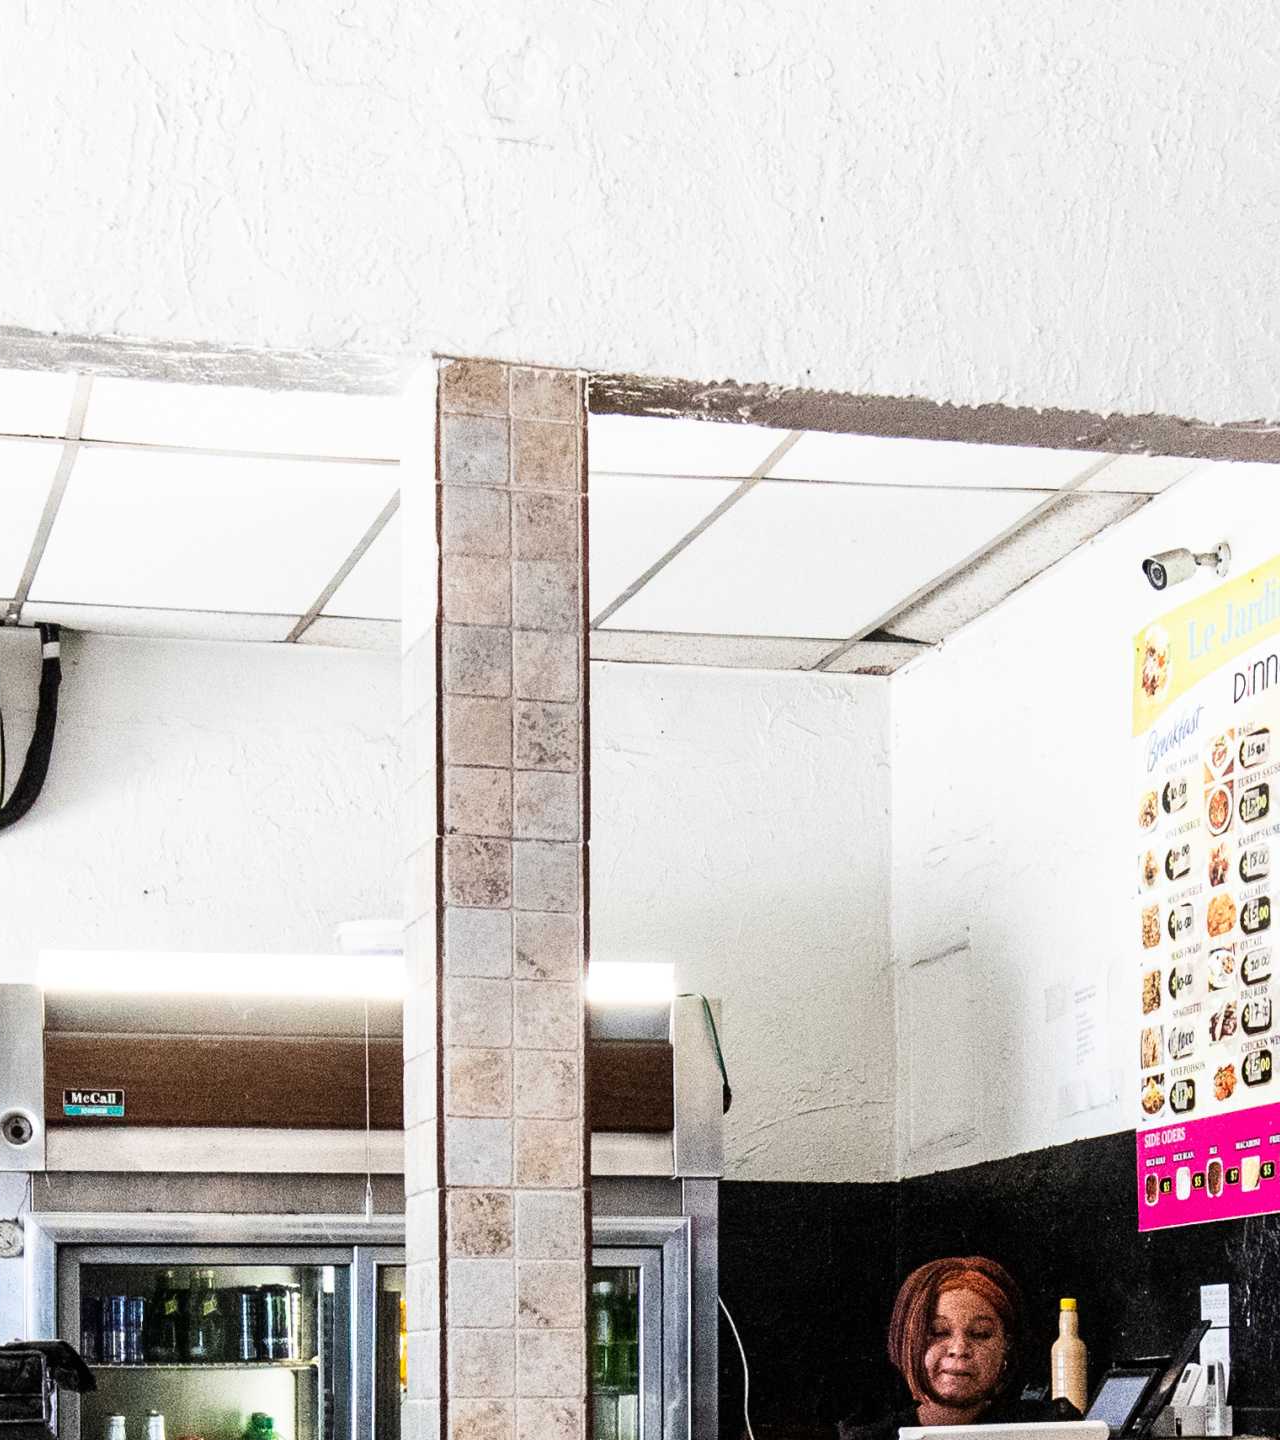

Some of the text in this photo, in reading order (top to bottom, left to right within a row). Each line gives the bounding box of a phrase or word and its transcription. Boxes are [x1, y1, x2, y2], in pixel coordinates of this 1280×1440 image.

[1188, 620, 1216, 662] Le
[1241, 1038, 1268, 1054] CHICKEN
[71, 1092, 117, 1104] McCall
[1144, 1127, 1186, 1148] SIDE ODERS
